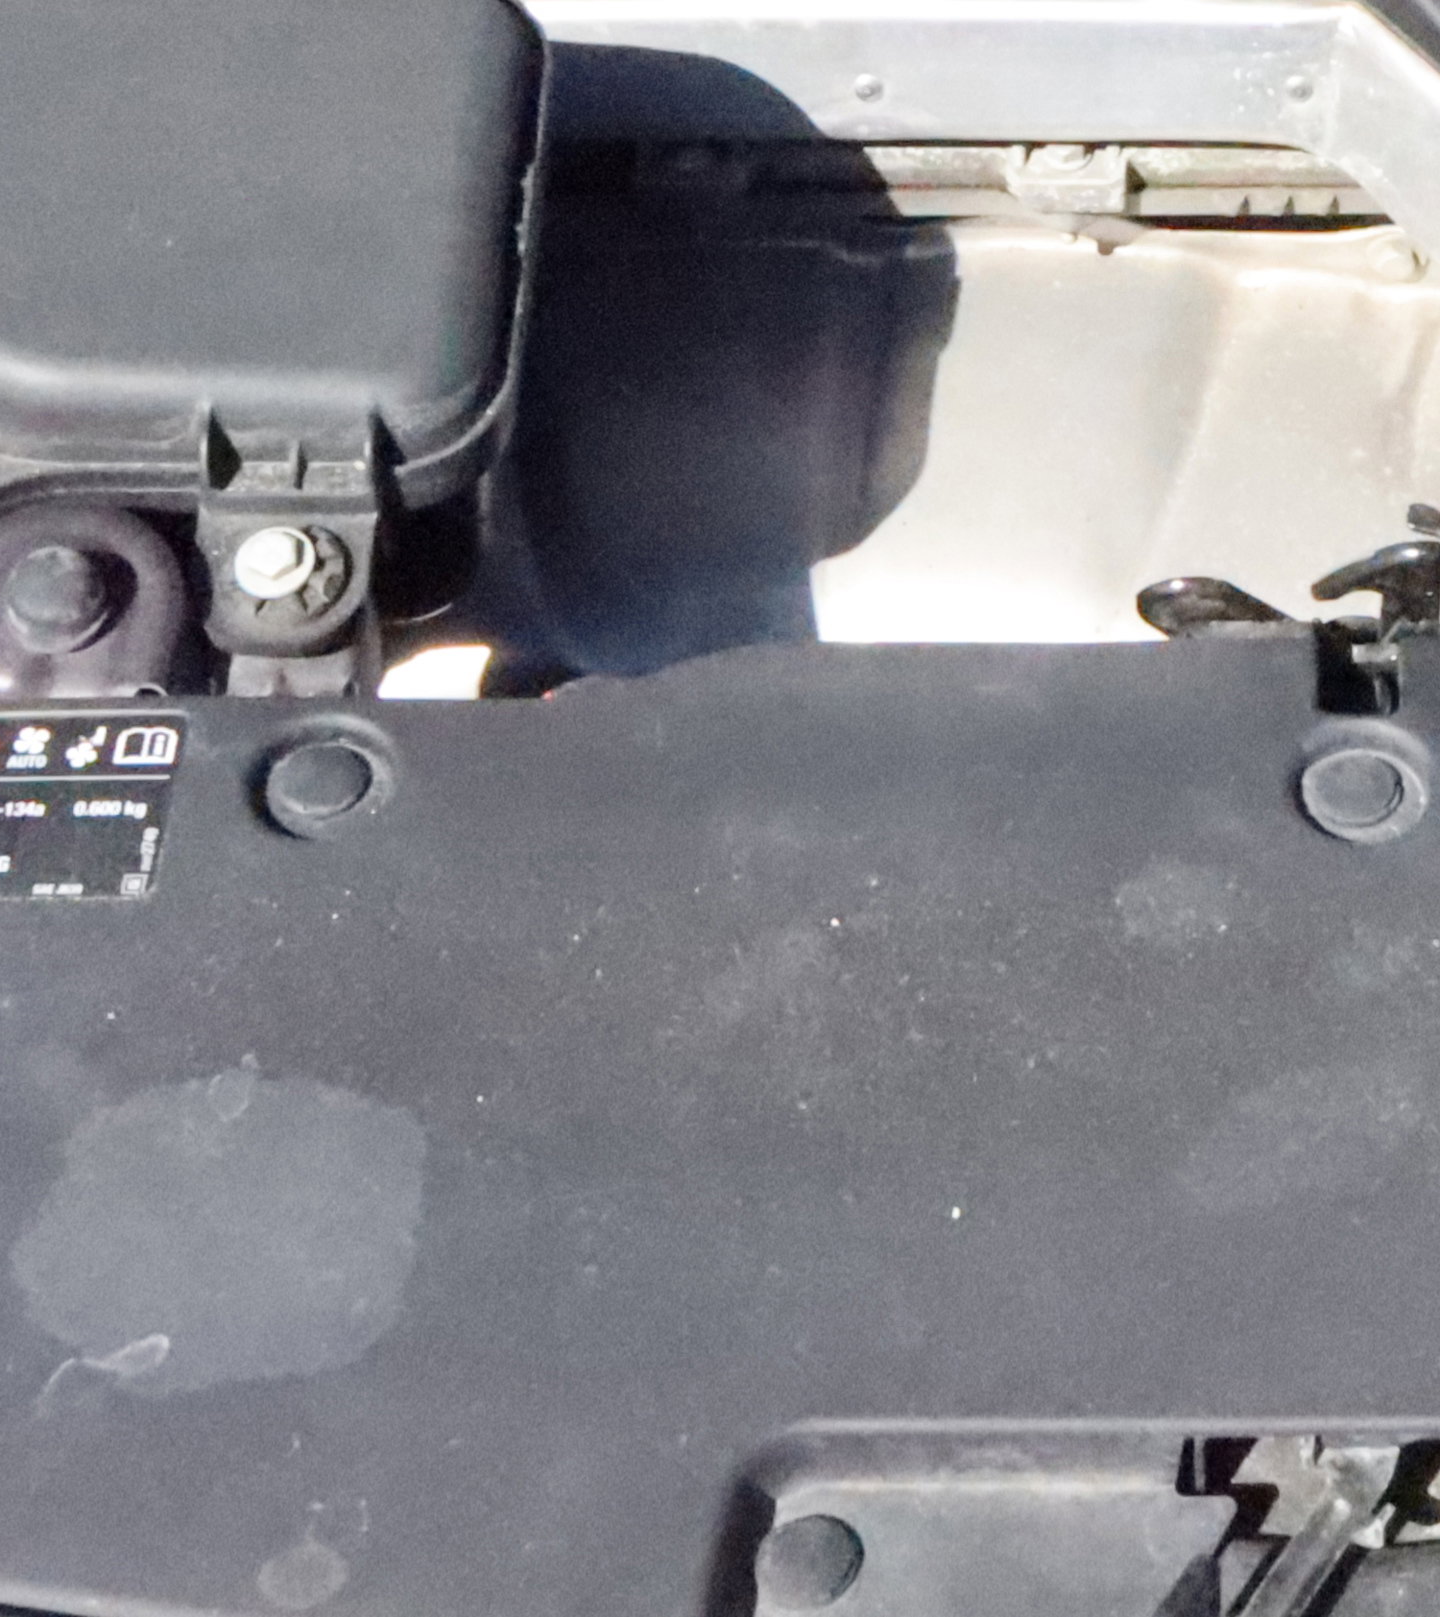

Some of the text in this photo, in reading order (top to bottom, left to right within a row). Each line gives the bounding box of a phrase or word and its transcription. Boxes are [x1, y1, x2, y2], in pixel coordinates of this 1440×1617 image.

[6, 754, 48, 769] AUTO
[72, 800, 122, 817] 0.600
[123, 800, 148, 820] kg
